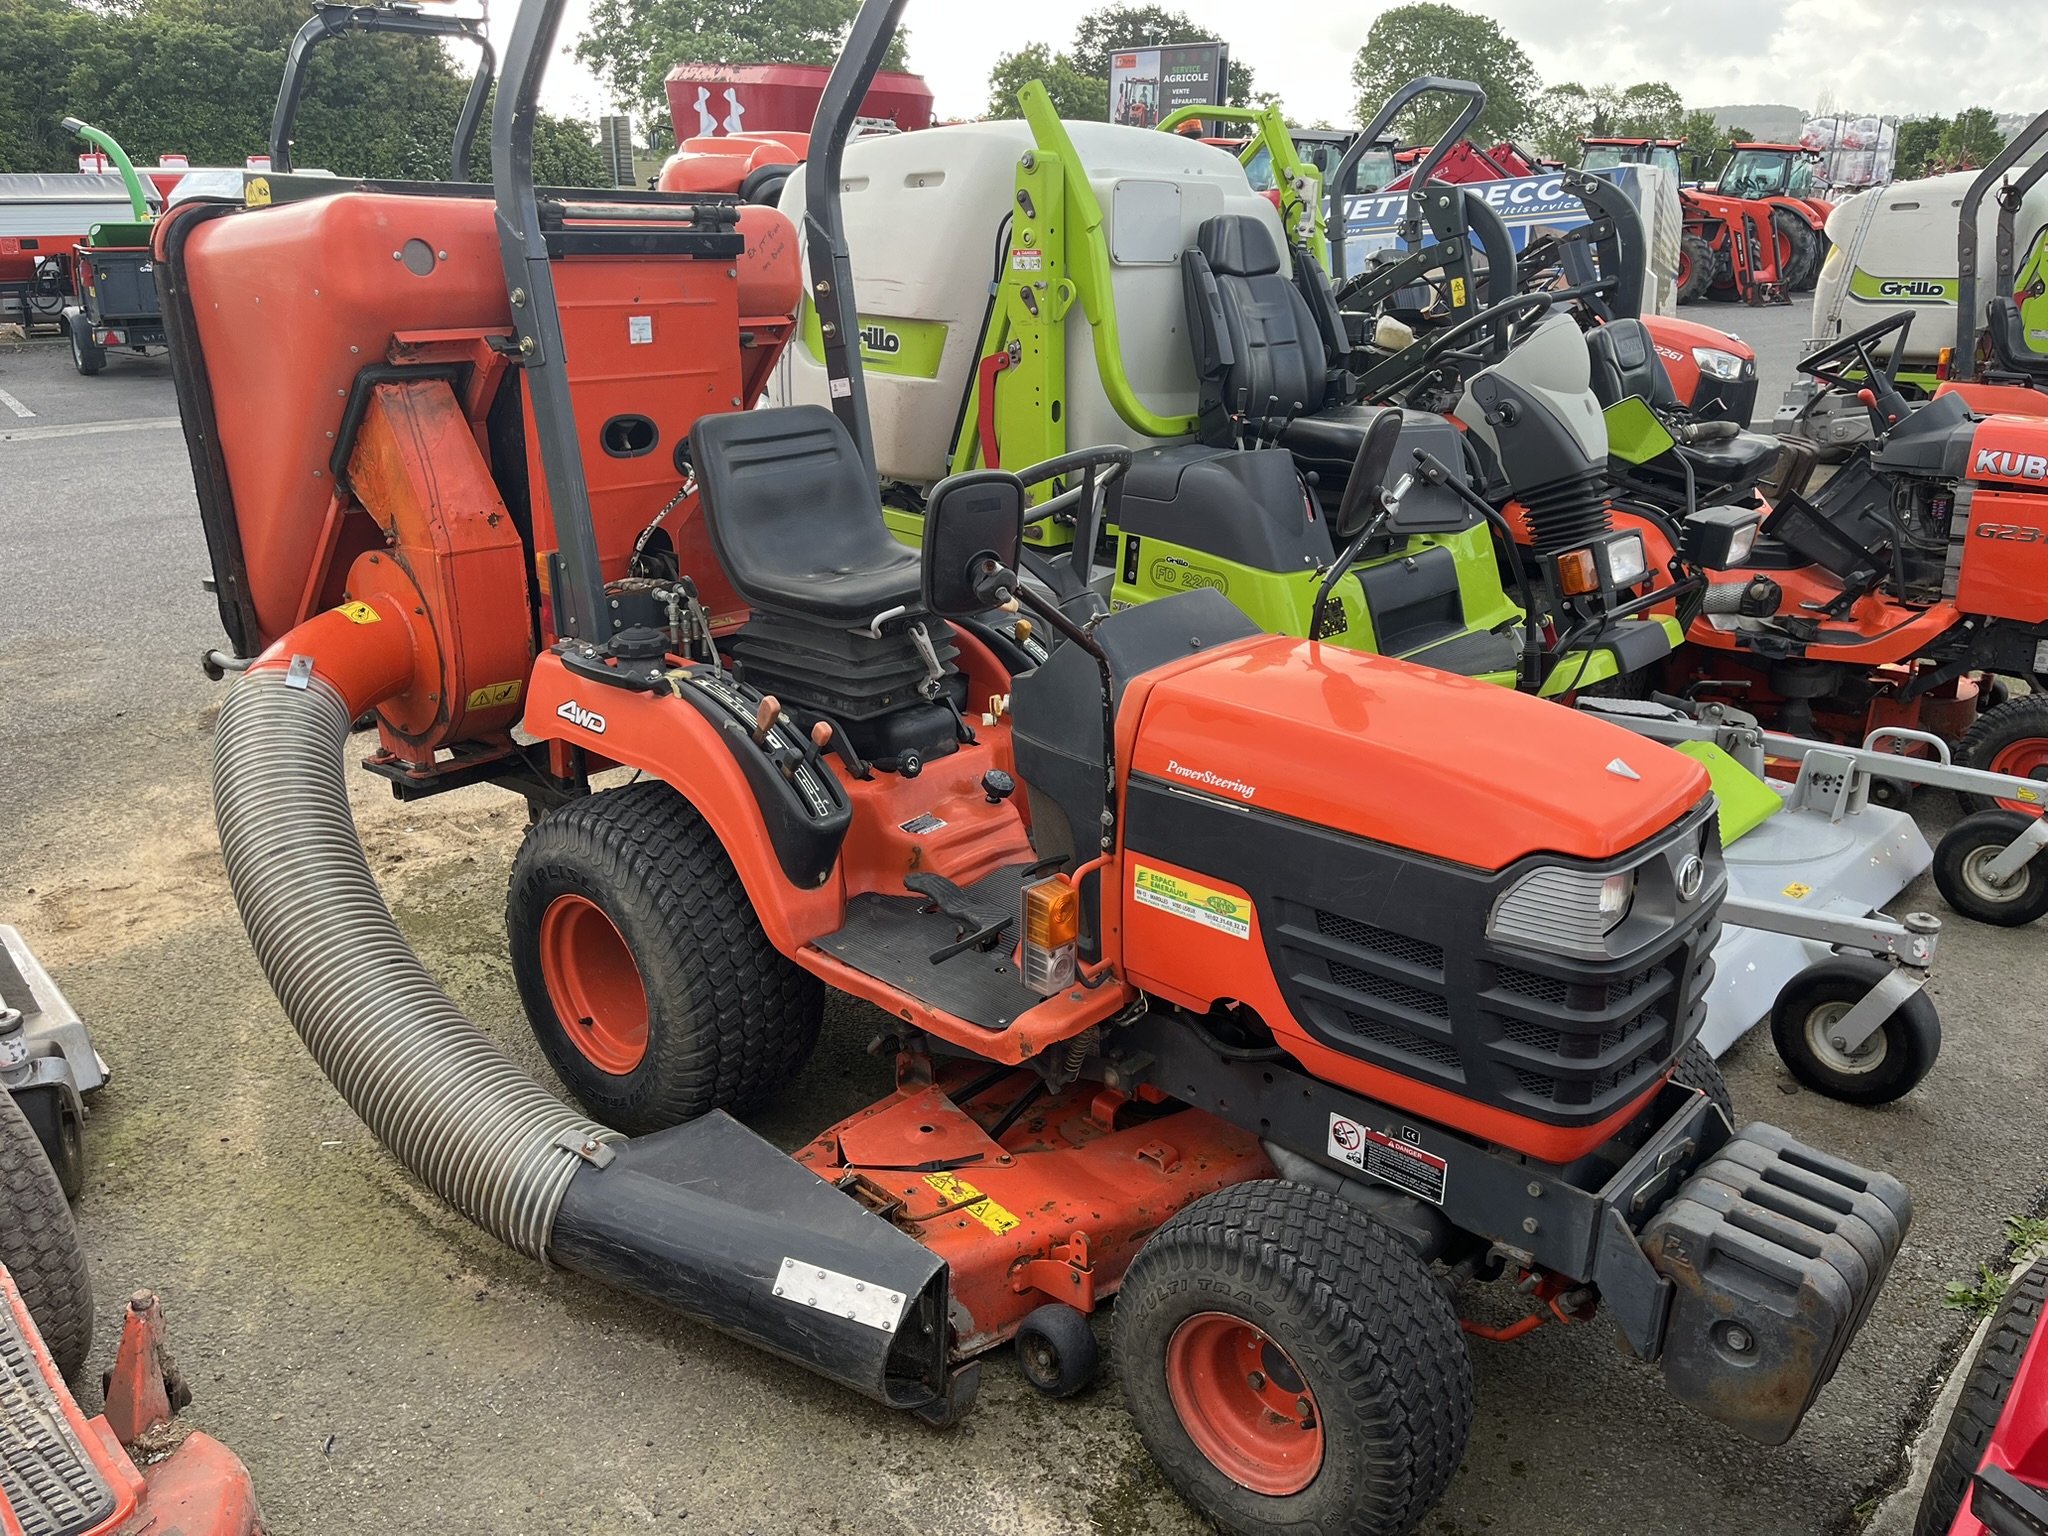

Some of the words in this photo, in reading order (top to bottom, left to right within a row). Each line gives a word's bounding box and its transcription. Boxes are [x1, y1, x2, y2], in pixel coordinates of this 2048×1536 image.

[1163, 73, 1209, 82] AGRICOLE
[1171, 65, 1201, 73] SERVICE
[1171, 96, 1207, 105] RÉPARATION
[1880, 281, 1945, 297] Grillo
[859, 326, 900, 354] rillo
[1974, 447, 2048, 480] KUB
[1166, 557, 1189, 567] Grillo
[1155, 565, 1176, 582] FD
[1182, 571, 1224, 592] 2200
[557, 700, 606, 733] 4WD
[1166, 760, 1256, 798] PowerSteering
[1150, 874, 1176, 887] ESPACE
[1150, 881, 1188, 899] EMERAUDE
[1395, 1141, 1423, 1160] DANGER
[1135, 1279, 1188, 1329] MULTI
[1198, 1278, 1275, 1316] TRAC
